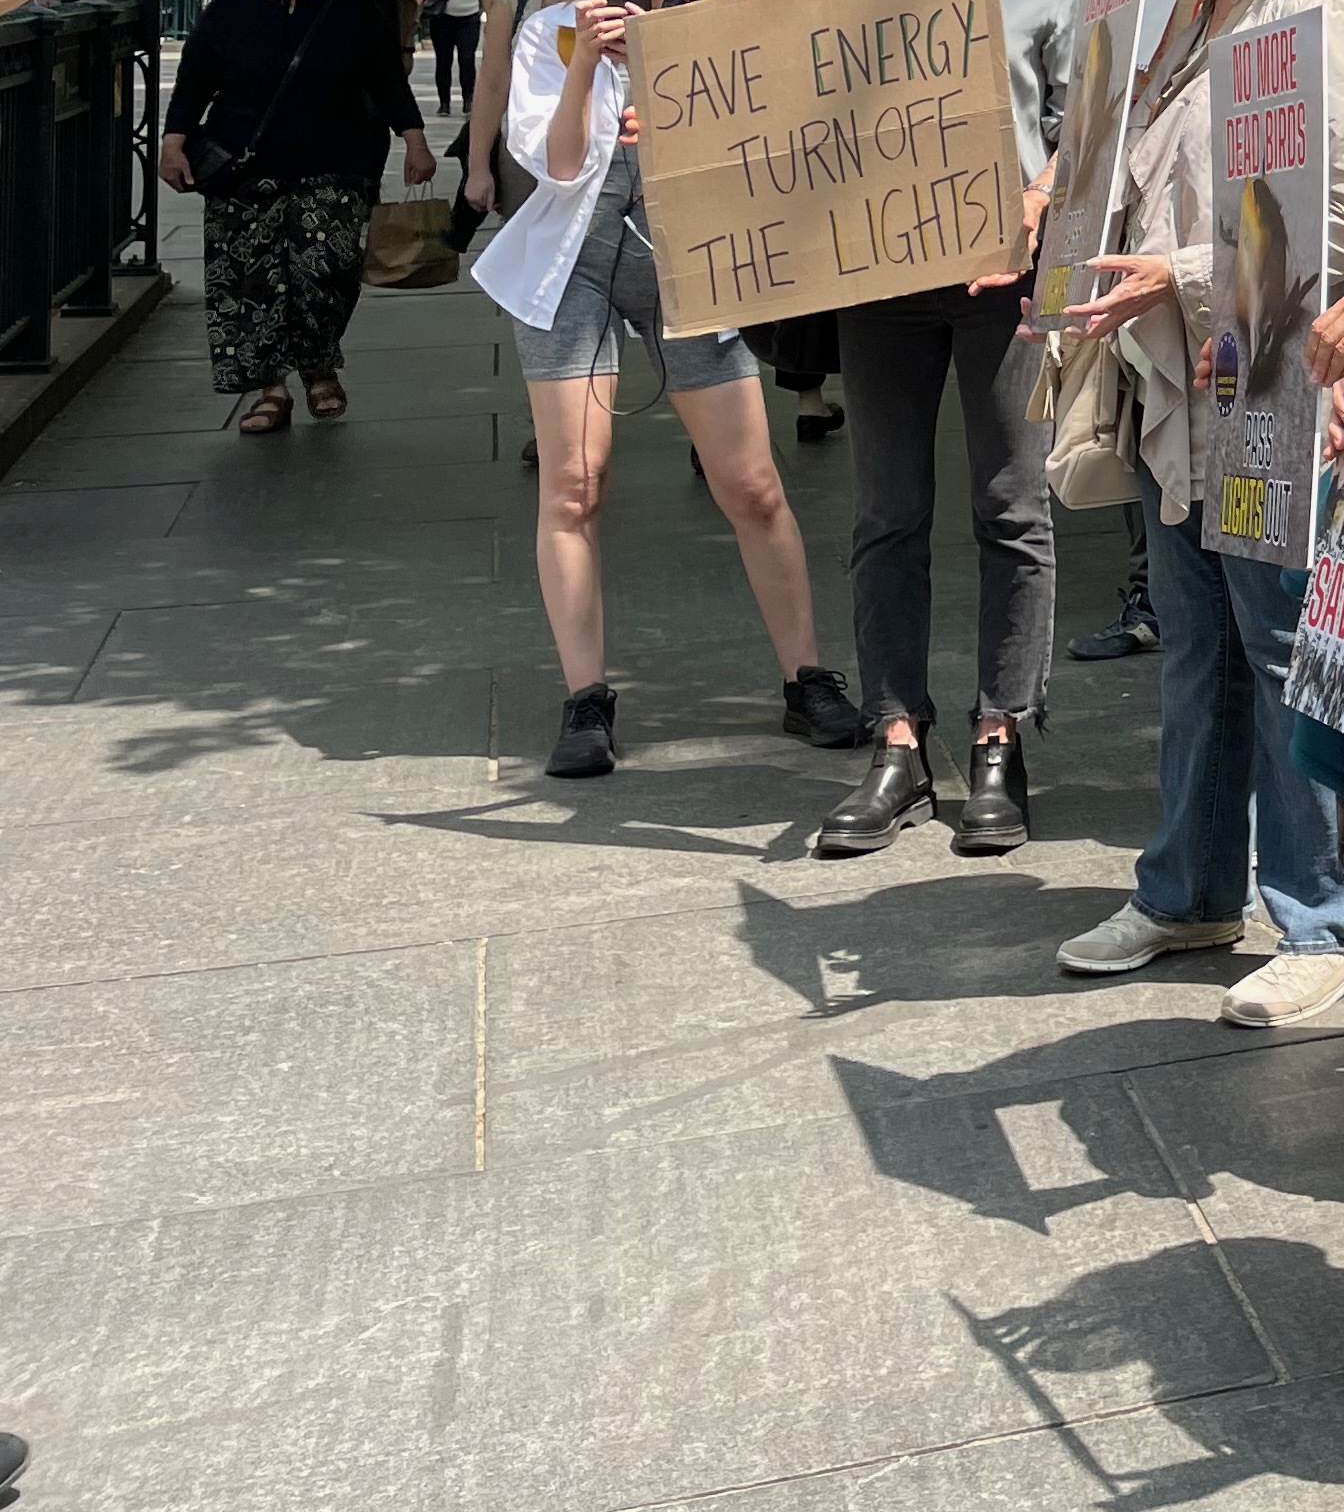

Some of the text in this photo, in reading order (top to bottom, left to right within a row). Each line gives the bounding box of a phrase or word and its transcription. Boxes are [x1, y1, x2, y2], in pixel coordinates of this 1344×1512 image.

[653, 0, 989, 130] SAVE ENERGY
[1232, 27, 1296, 103] NO MORE
[728, 90, 969, 197] TURN OFF
[1226, 101, 1306, 178] DEAD BIRDS
[688, 221, 794, 305] THE
[829, 161, 1005, 275] LIGHTS!
[1243, 412, 1274, 470] PASS
[1221, 474, 1292, 547] LIGHTS OUT
